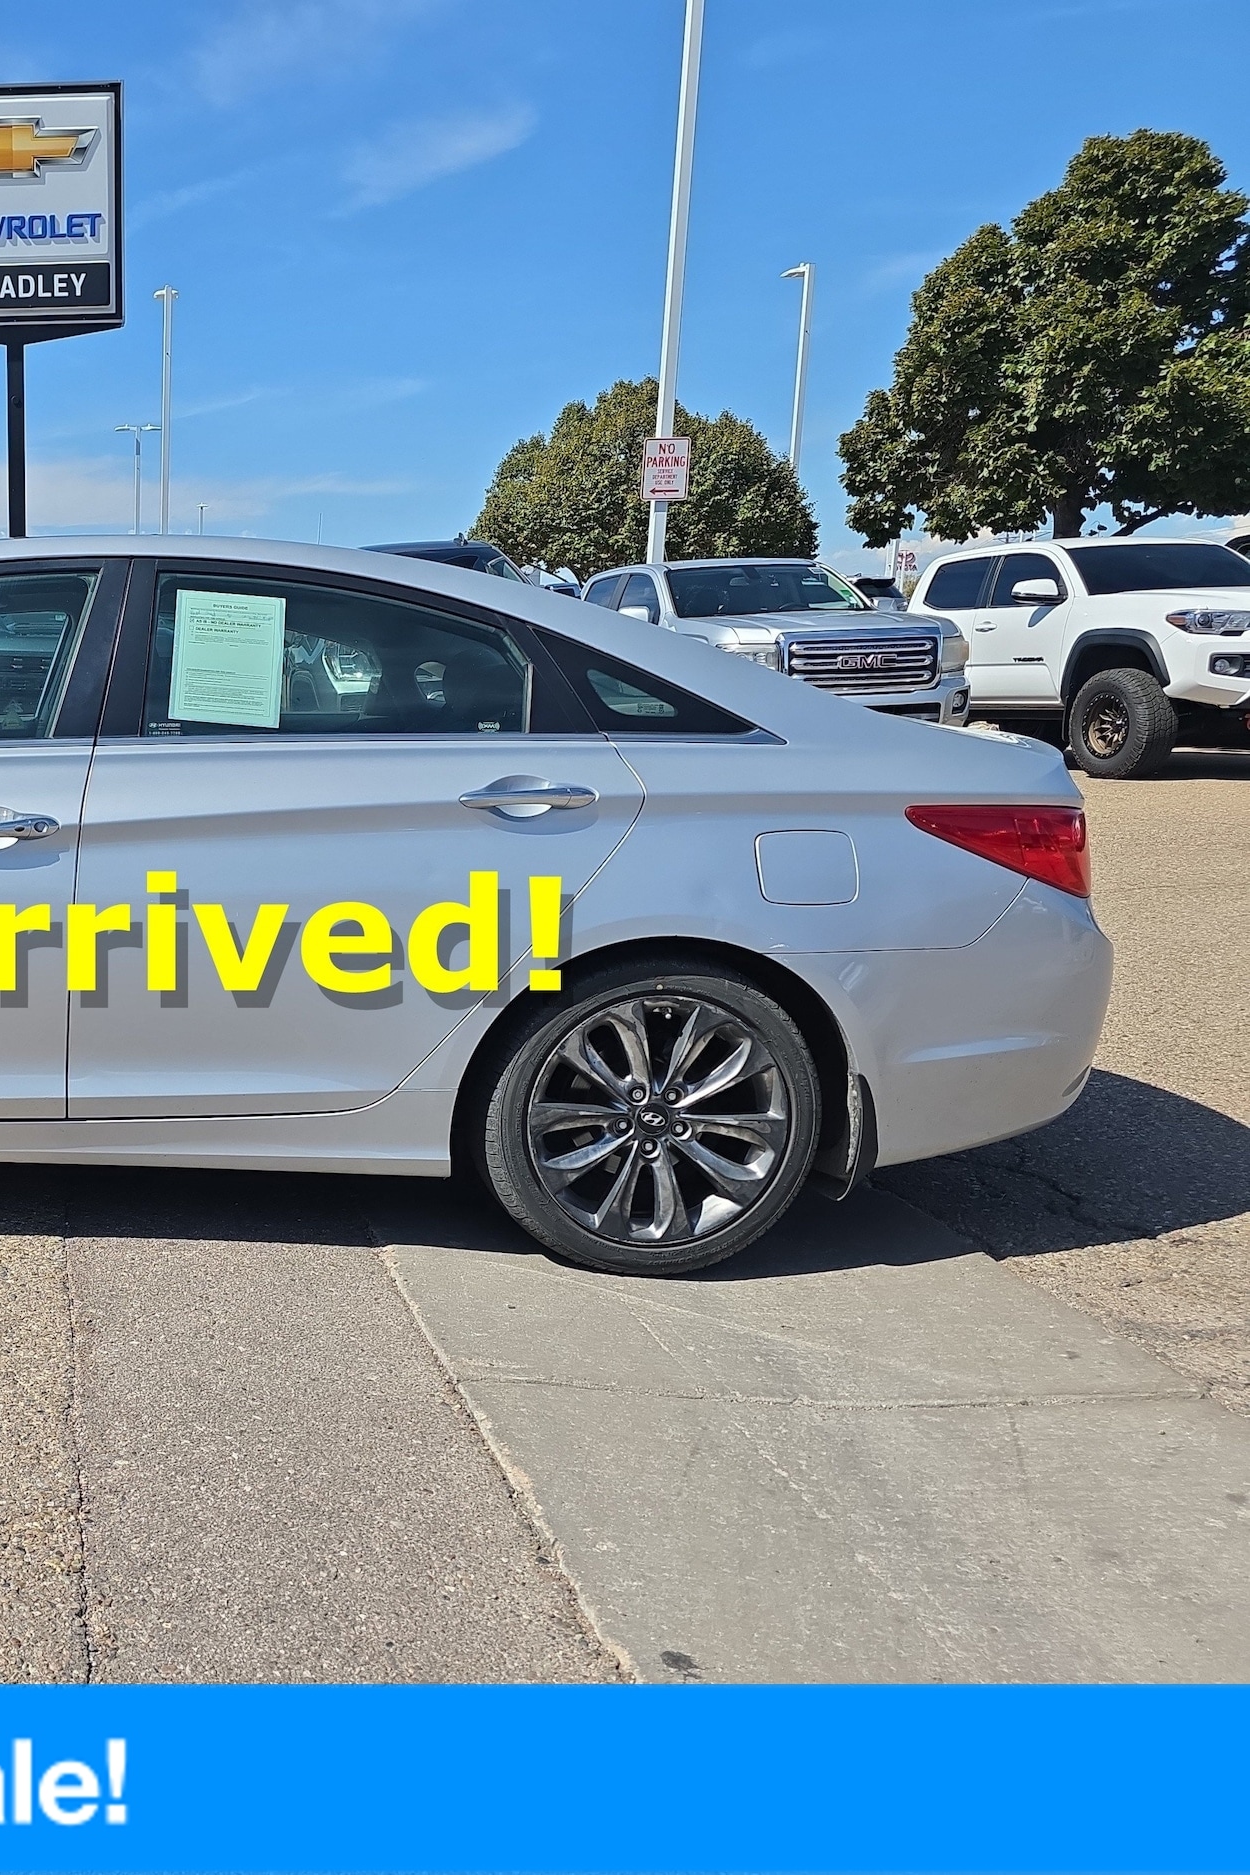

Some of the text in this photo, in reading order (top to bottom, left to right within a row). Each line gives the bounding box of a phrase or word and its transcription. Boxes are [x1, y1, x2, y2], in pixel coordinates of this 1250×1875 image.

[658, 443, 676, 455] NO
[646, 455, 686, 468] PARKING
[837, 654, 897, 669] GMC
